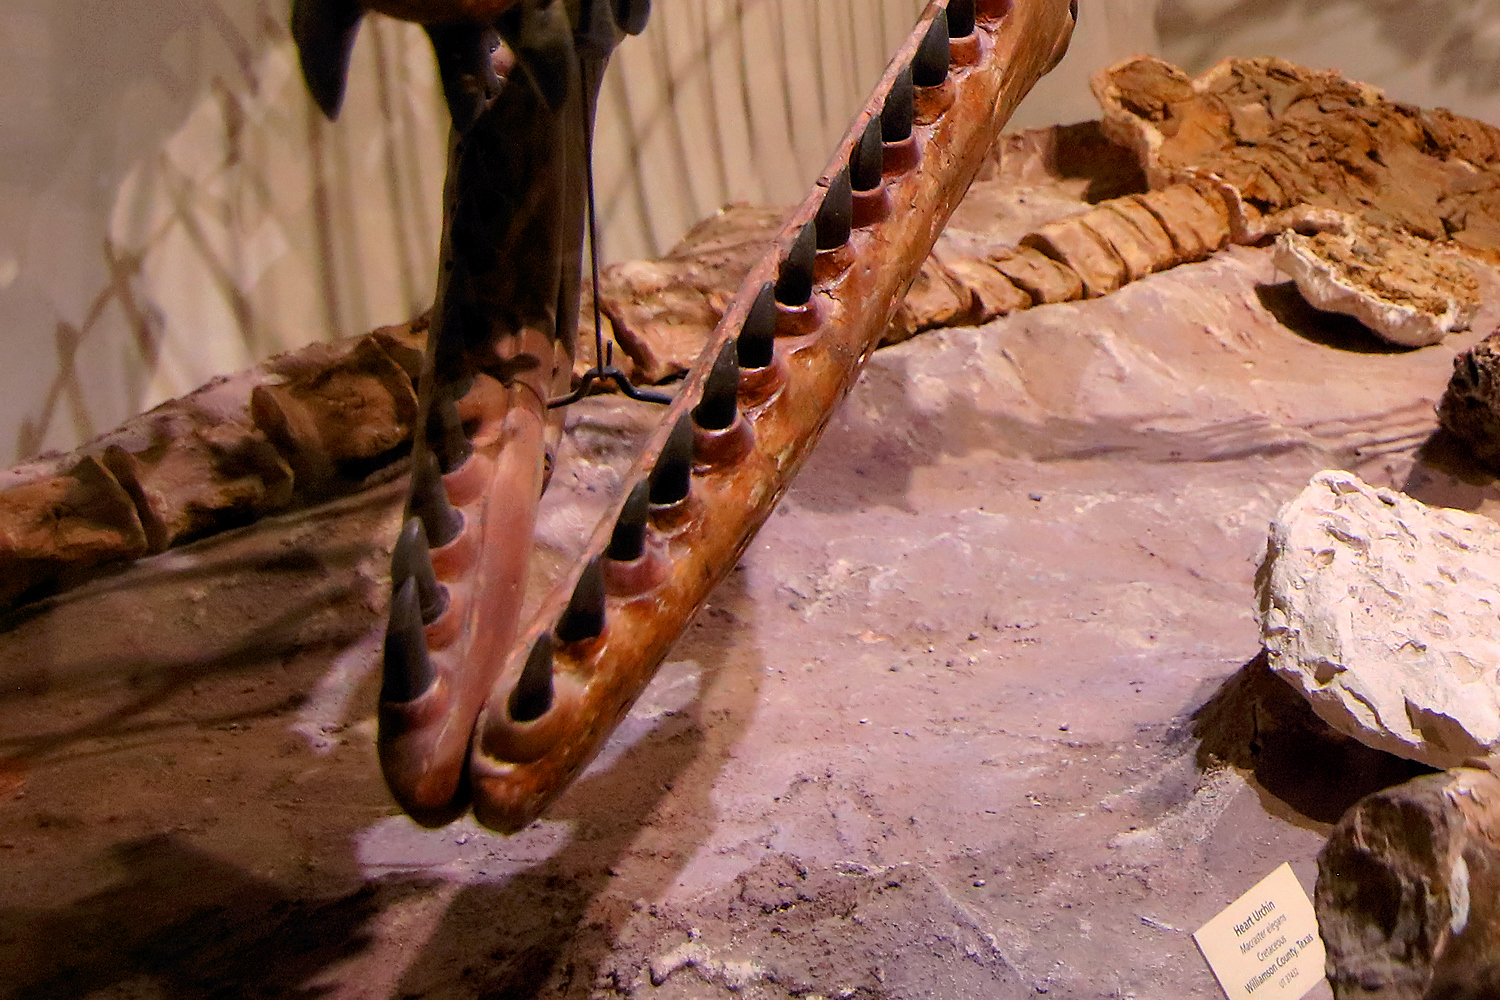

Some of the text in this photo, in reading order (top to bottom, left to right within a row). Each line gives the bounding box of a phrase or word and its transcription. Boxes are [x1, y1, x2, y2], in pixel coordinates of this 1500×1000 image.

[1233, 900, 1276, 937] Heart Urchin
[1239, 913, 1287, 955] Macraster elegans
[1244, 933, 1314, 994] Williamson County, Texas
[1256, 935, 1287, 962] Cretaceous
